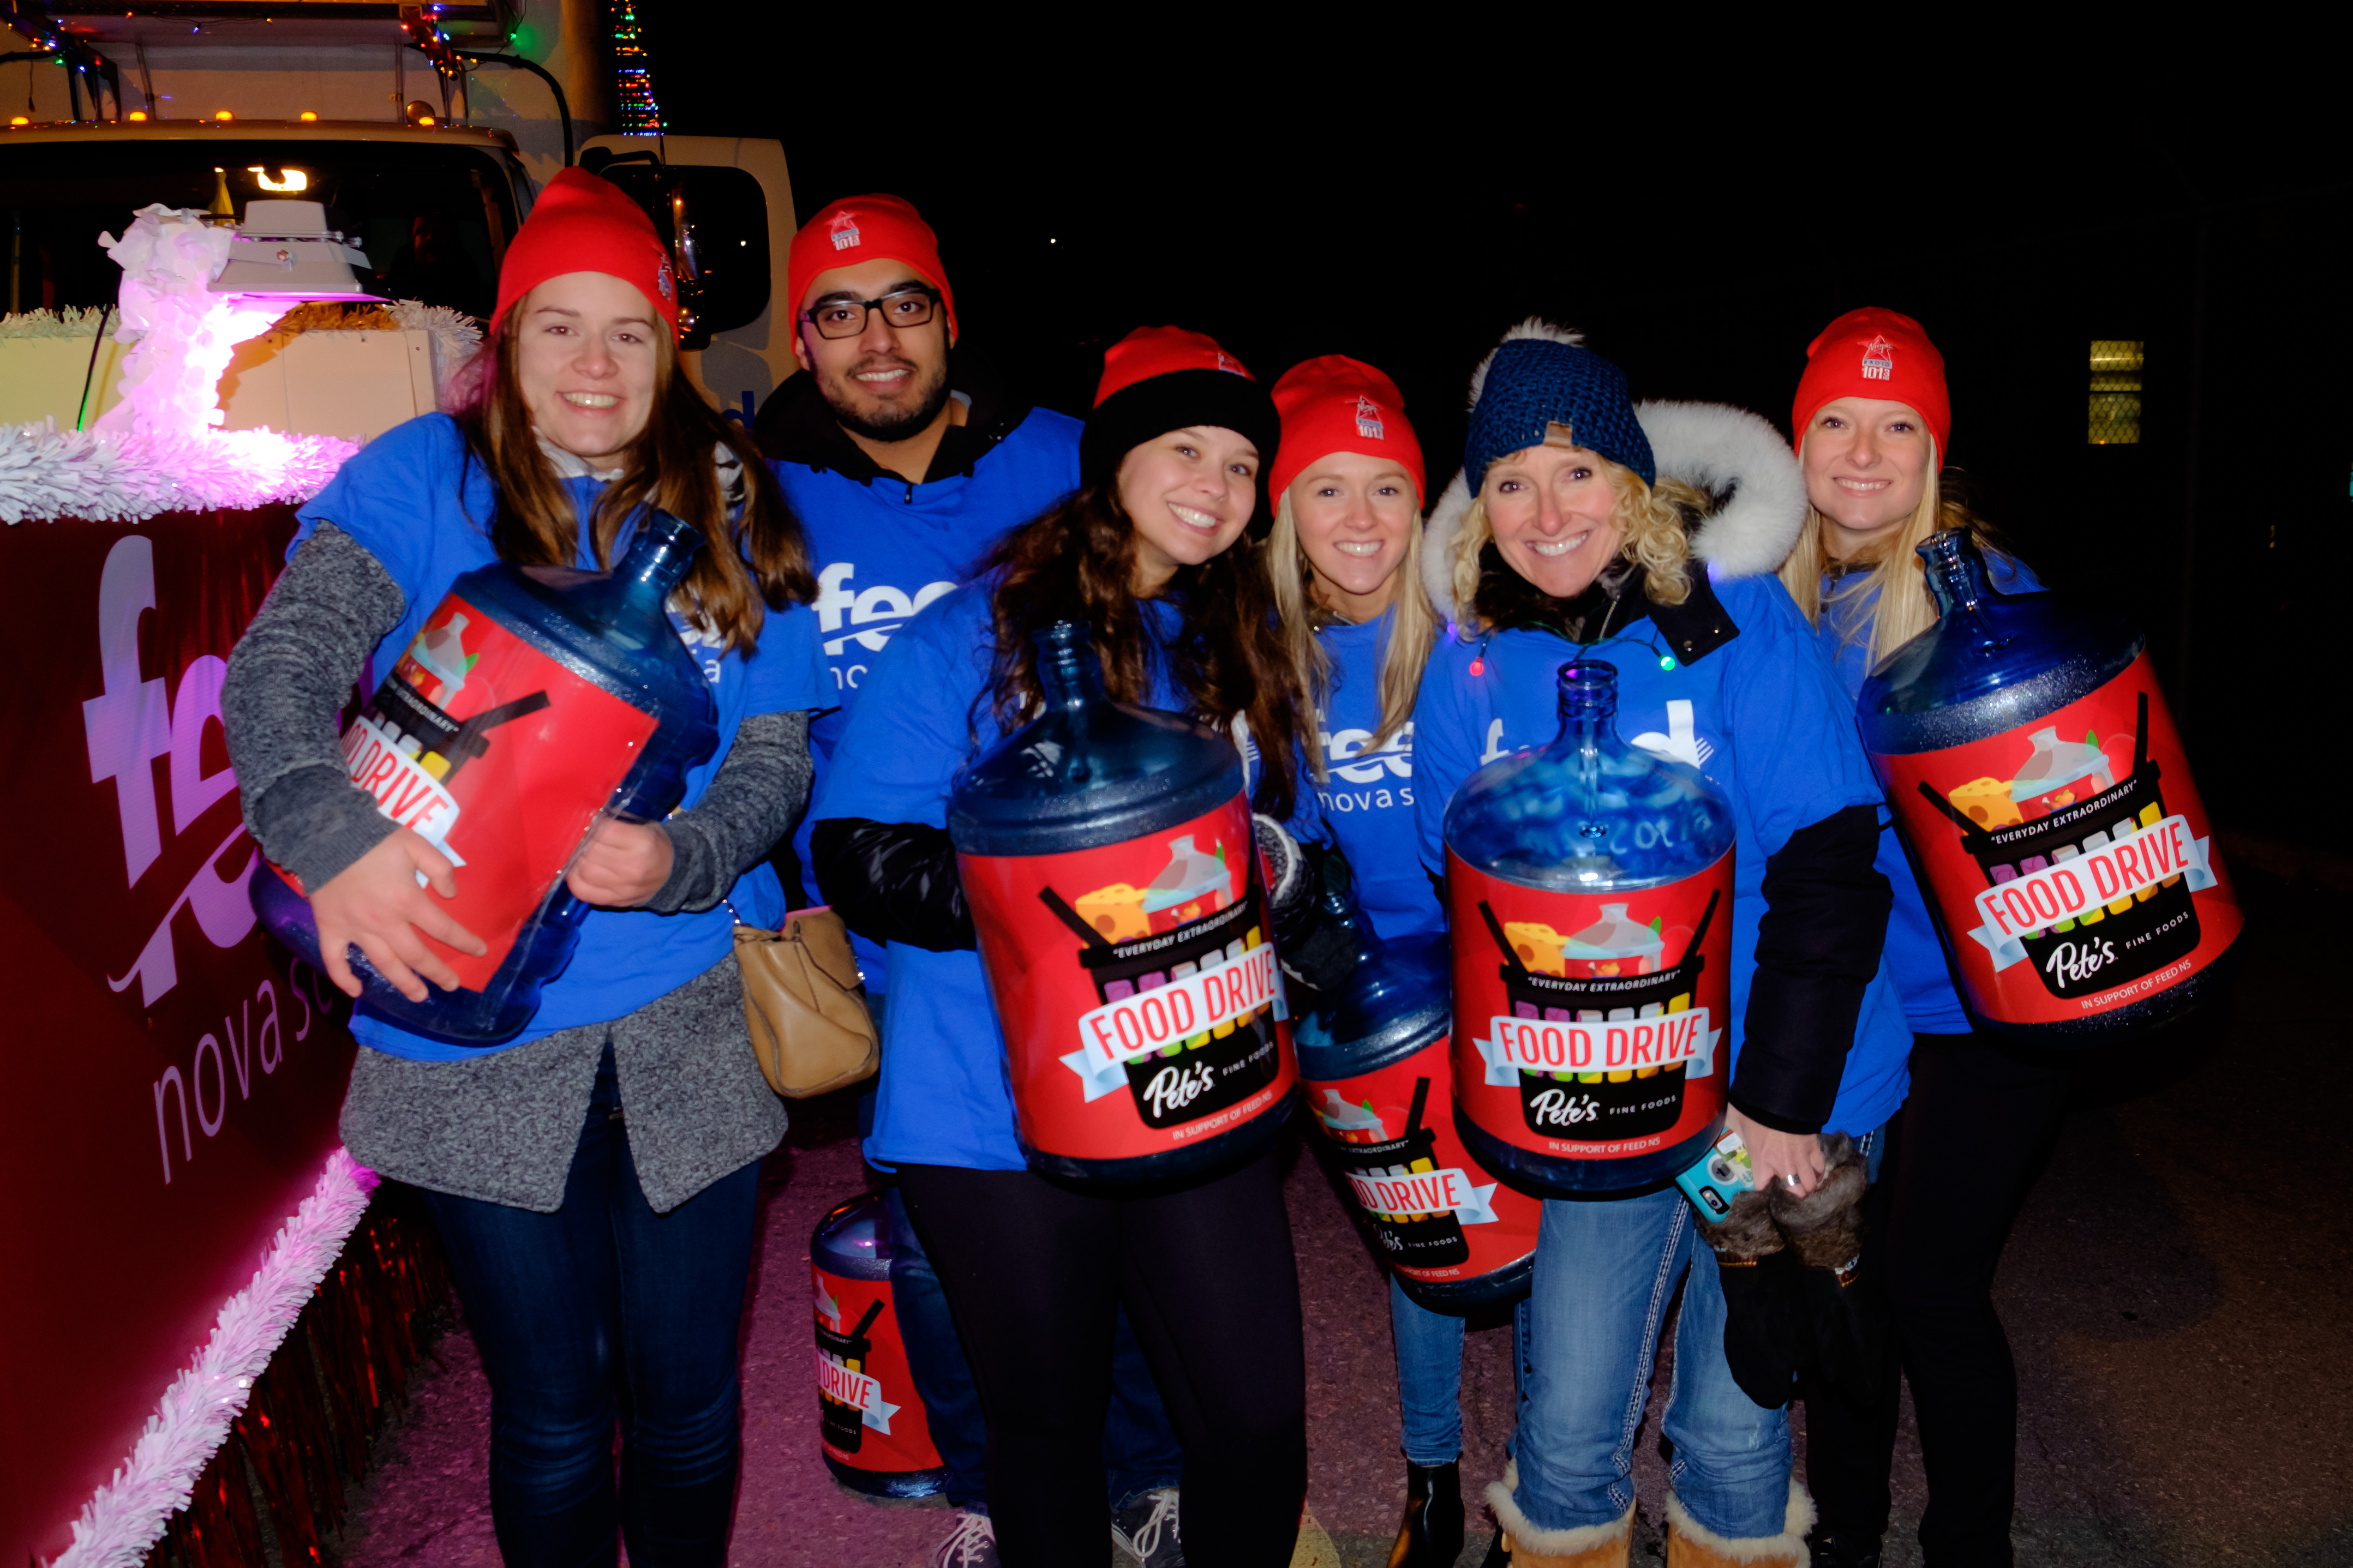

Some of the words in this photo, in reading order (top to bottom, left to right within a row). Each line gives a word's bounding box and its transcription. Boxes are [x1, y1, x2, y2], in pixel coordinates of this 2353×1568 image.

[350, 740, 449, 830] DRIVE
[1317, 789, 1393, 813] nova
[1983, 869, 2086, 936] FOOD
[2087, 821, 2189, 900] DRIVE
[2045, 936, 2116, 989] Pete's
[2126, 932, 2152, 950] FINE
[2156, 911, 2189, 935] FOODS
[1088, 988, 1195, 1061] FOOD
[1202, 949, 1275, 1023] DRIVE
[2080, 999, 2093, 1010] IN
[2093, 984, 2139, 1007] SUPPORT
[2140, 978, 2154, 991] OF
[2155, 966, 2178, 984] FEED
[2178, 959, 2192, 973] NS
[1498, 1022, 1592, 1068] FOOD
[1606, 1014, 1702, 1067] DRIVE
[153, 979, 283, 1185] nova
[1142, 1061, 1214, 1119] Pete's
[1222, 1059, 1247, 1077] FINE
[1248, 1040, 1274, 1064] FOODS
[1172, 1128, 1185, 1141] IN
[1185, 1113, 1229, 1137] SUPPORT
[1229, 1107, 1242, 1121] OF
[1242, 1096, 1263, 1115] FEED
[1261, 1089, 1273, 1103] NS
[1529, 1088, 1600, 1127] Pete's
[1609, 1105, 1636, 1115] FINE
[1641, 1094, 1677, 1111] FOODS
[1548, 1142, 1559, 1151] IN
[1561, 1143, 1606, 1154] SUPPORT
[1607, 1143, 1620, 1154] OF
[1623, 1139, 1647, 1152] FEED
[1648, 1136, 1661, 1146] NS
[1374, 1174, 1461, 1211] DRIVE
[1428, 1236, 1458, 1247] FOODS
[822, 1359, 874, 1409] DRIVE
